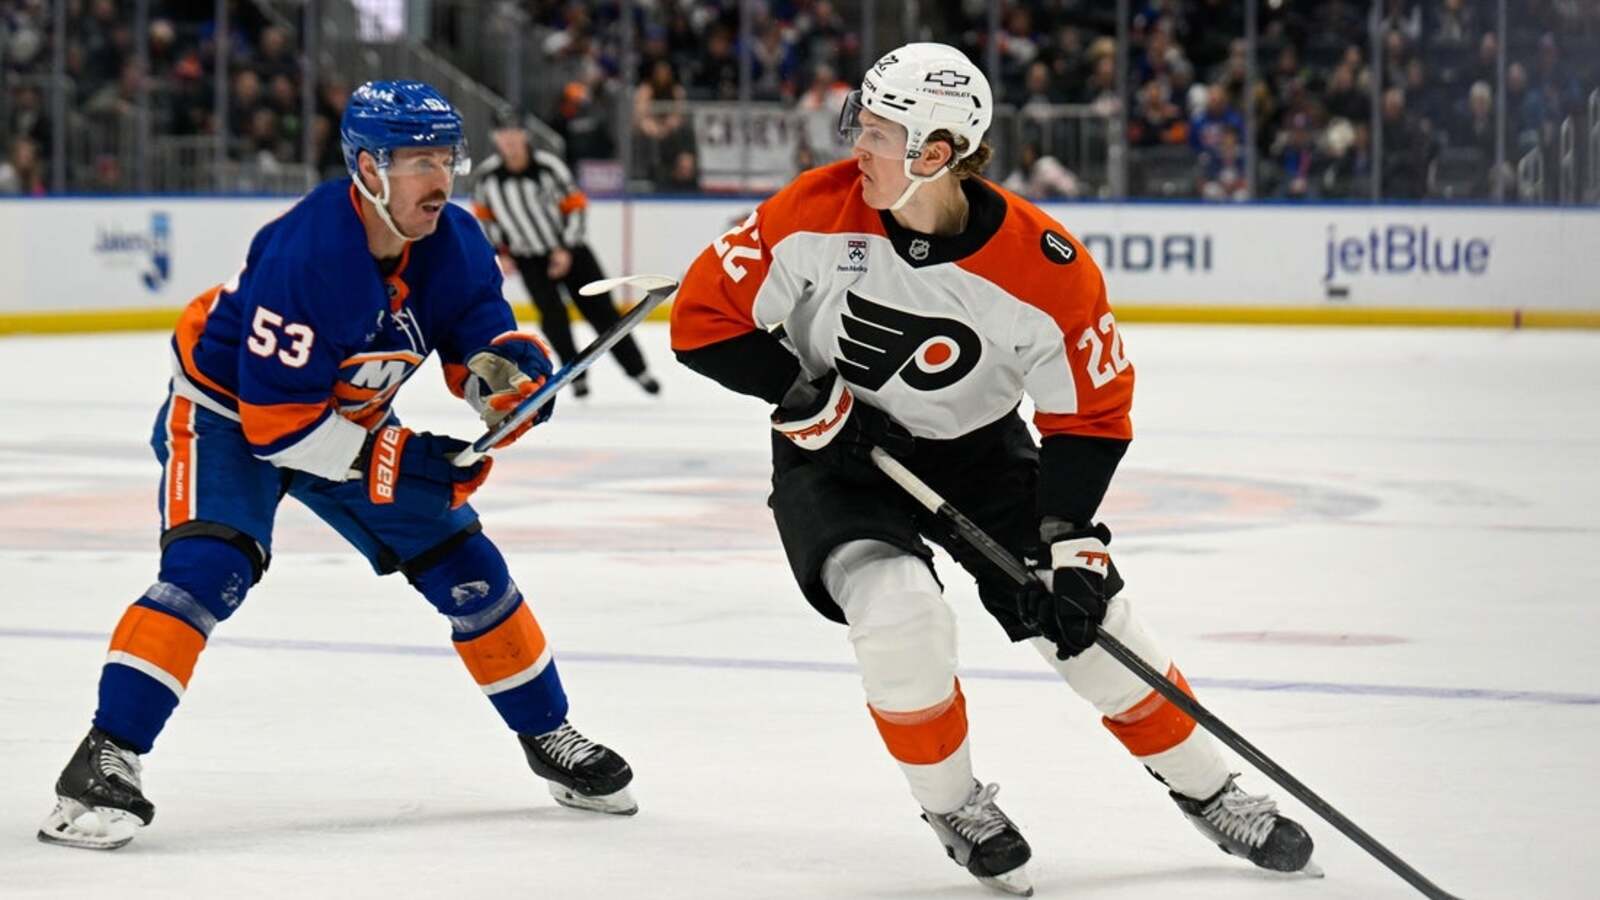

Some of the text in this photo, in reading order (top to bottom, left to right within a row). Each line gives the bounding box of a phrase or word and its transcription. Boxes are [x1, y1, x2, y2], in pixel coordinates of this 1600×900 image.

[923, 87, 971, 98] CHEVROLET
[1083, 234, 1213, 271] NDAI
[1322, 223, 1490, 283] jetBlue
[247, 305, 315, 368] 53
[1076, 311, 1131, 390] 22
